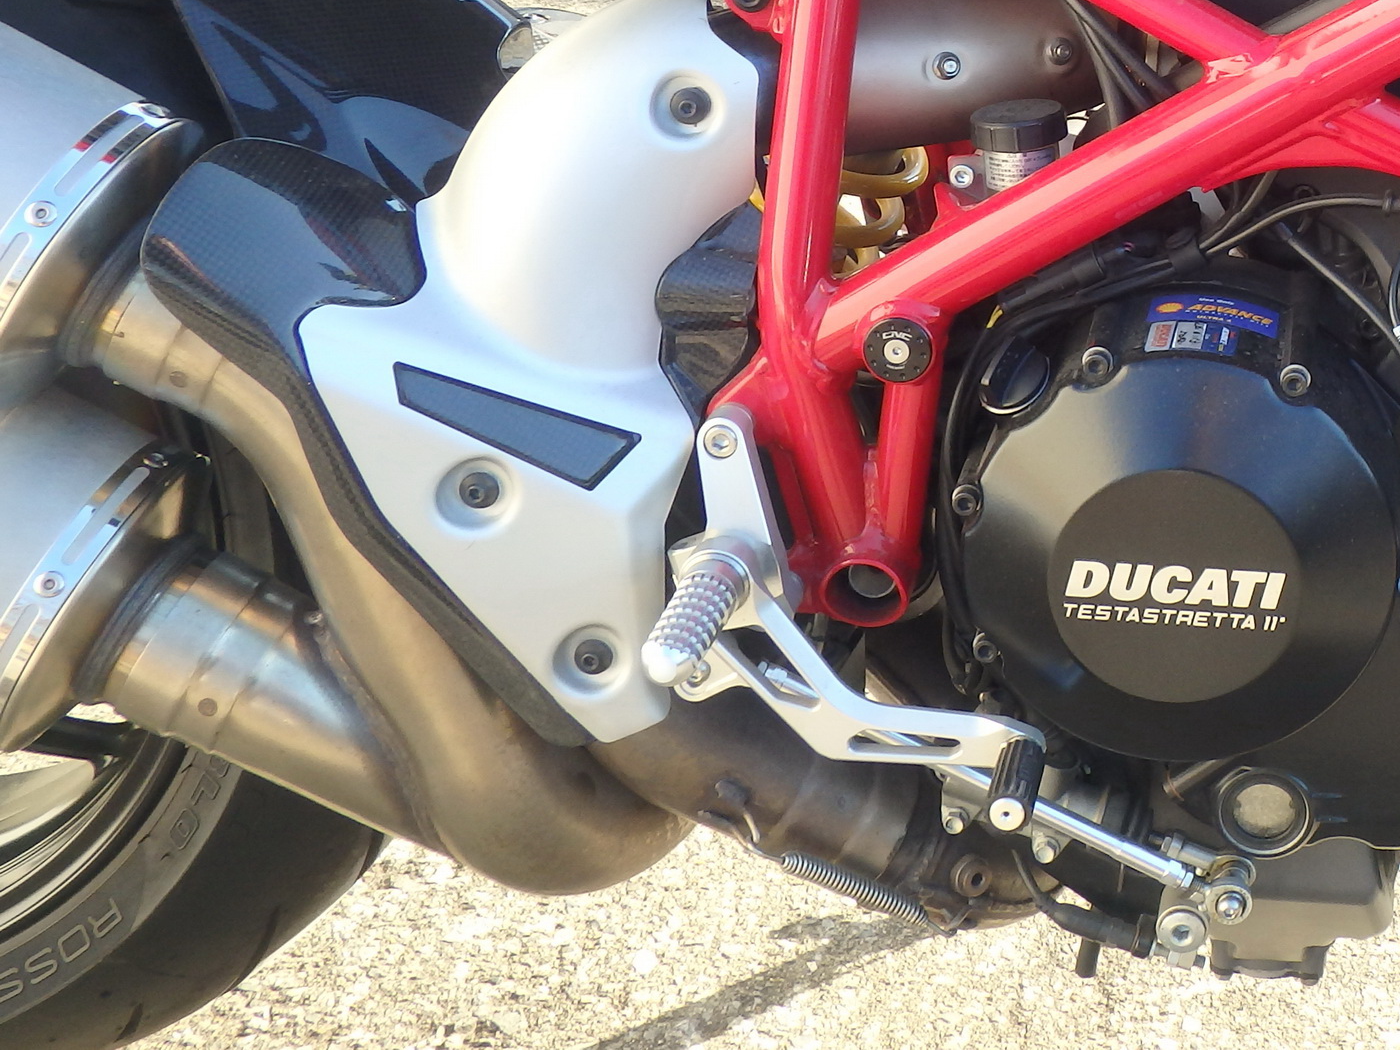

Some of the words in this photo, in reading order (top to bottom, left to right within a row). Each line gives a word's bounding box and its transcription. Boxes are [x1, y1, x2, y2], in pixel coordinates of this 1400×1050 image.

[1186, 303, 1274, 325] ADVANCE
[1064, 560, 1287, 610] DUCATI
[1063, 602, 1256, 631] TESTASTRETTA
